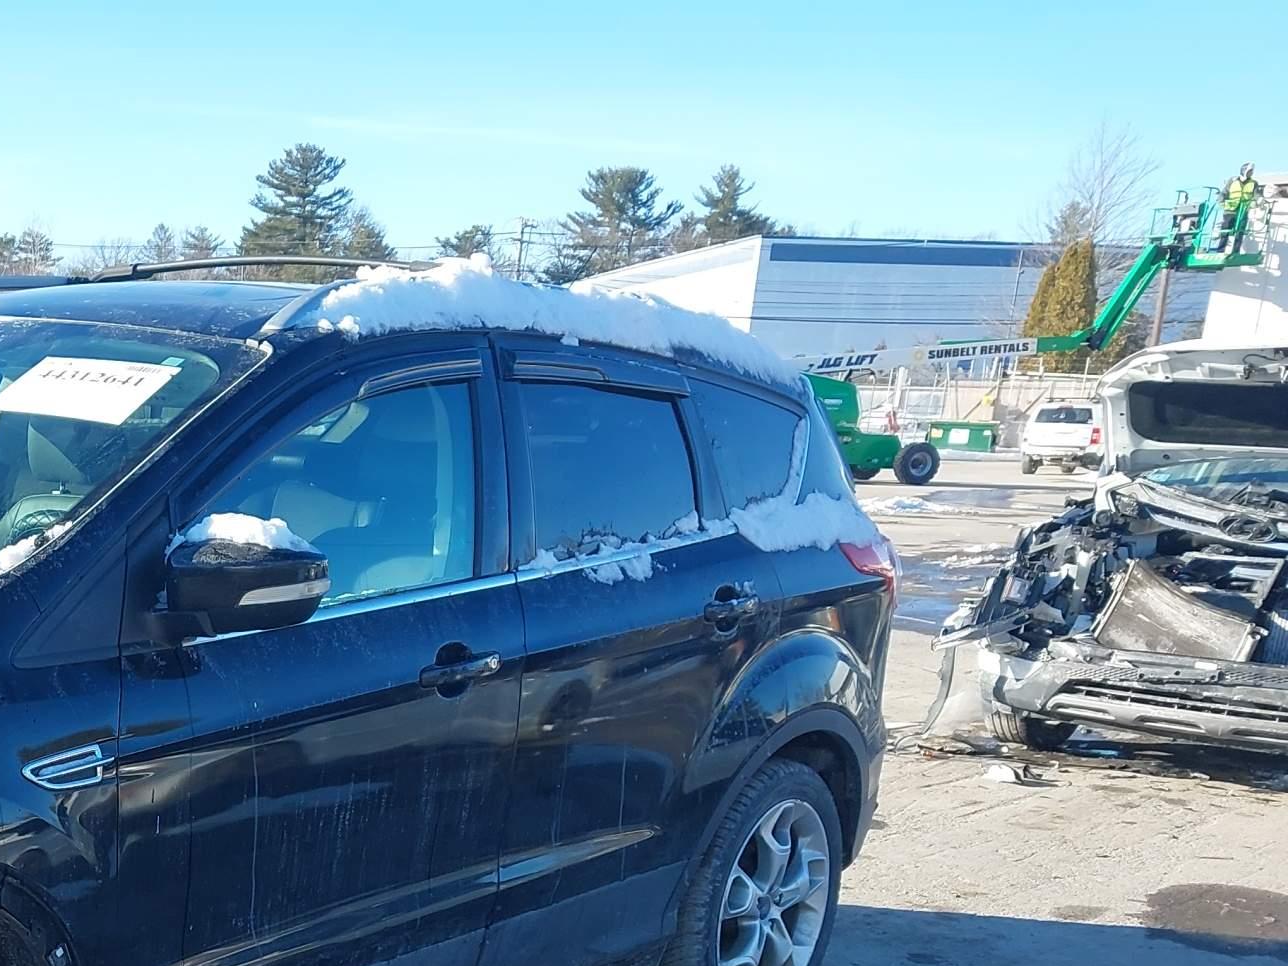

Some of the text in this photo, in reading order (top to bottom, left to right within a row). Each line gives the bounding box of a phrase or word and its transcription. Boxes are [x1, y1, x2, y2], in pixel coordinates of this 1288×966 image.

[928, 342, 1029, 359] SUNBELT RENTALS
[817, 353, 878, 369] JLG LIFT
[40, 370, 145, 386] 44312641
